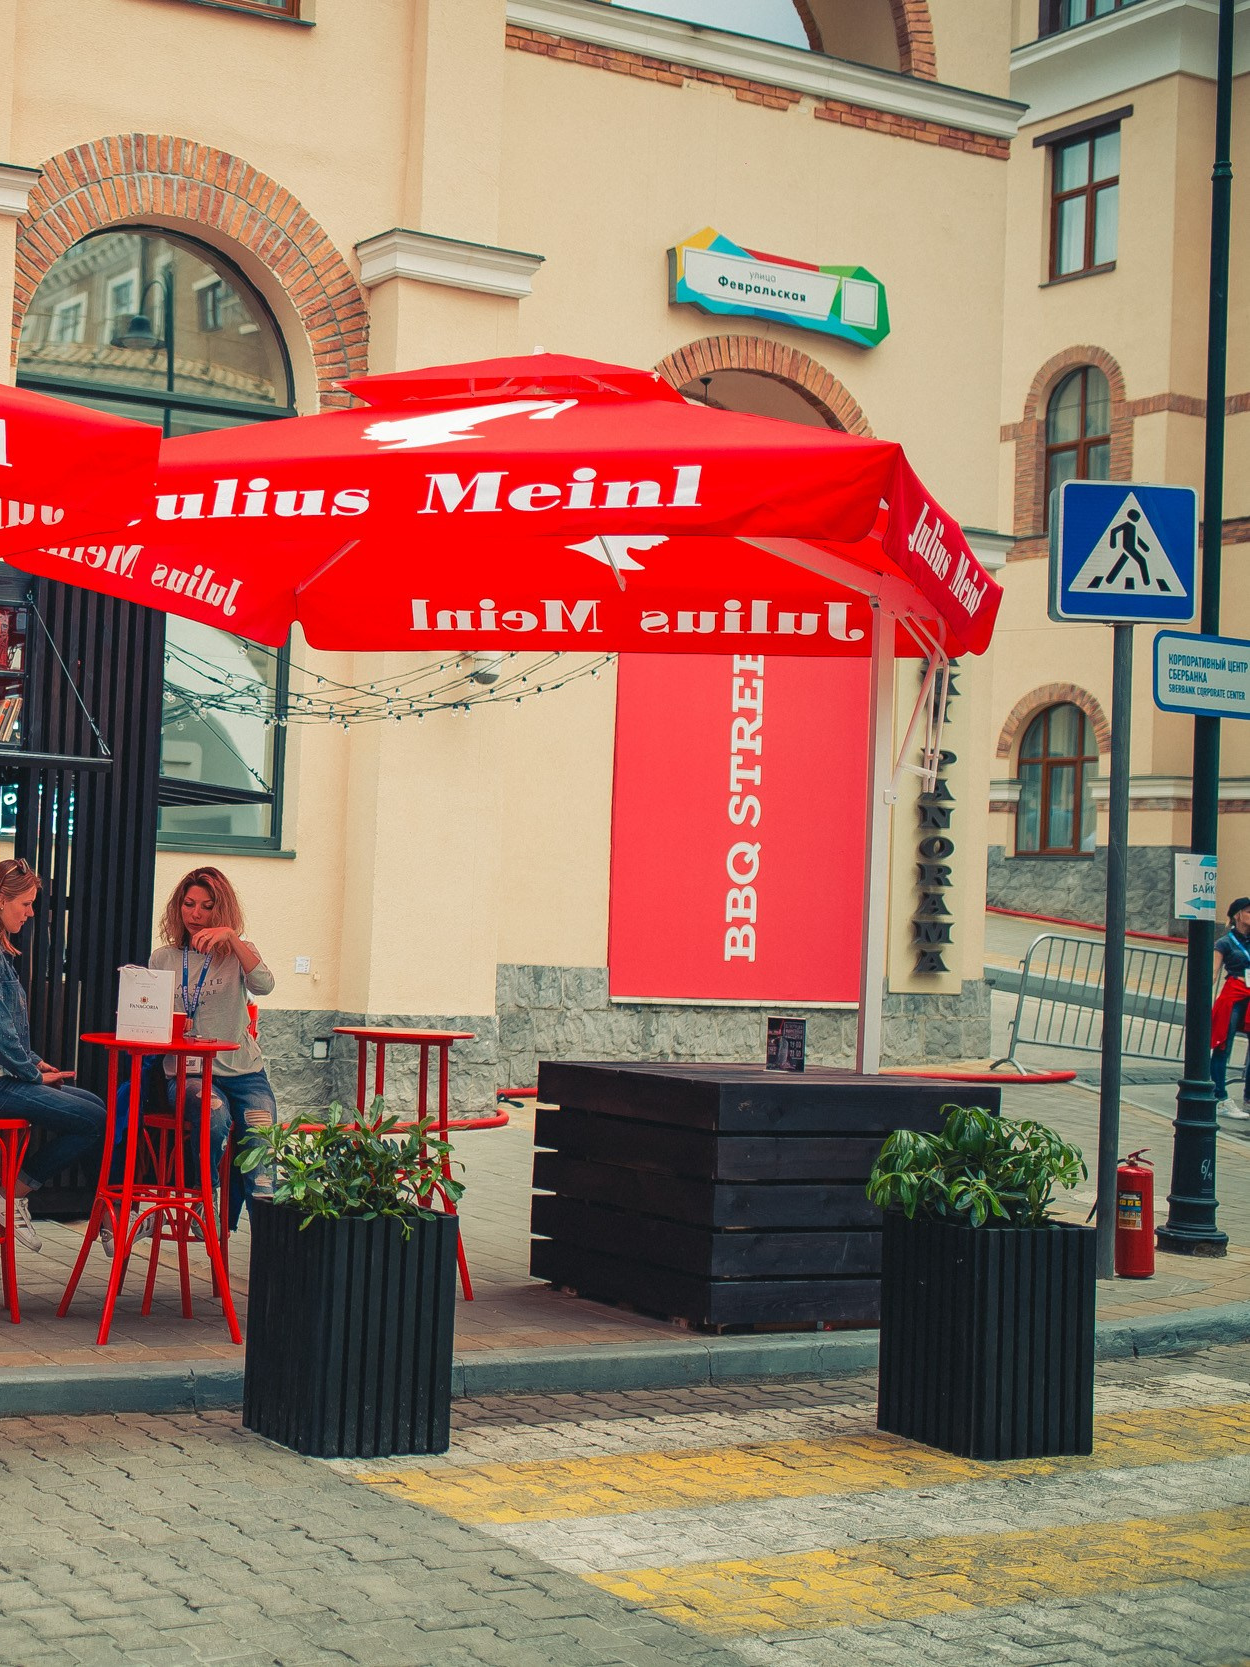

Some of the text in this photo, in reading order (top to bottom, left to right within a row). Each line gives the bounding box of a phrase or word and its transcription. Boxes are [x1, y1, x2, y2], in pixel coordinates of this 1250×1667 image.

[749, 270, 777, 284] улица
[717, 275, 807, 303] Февральская
[153, 464, 703, 521] ulius Meinl
[908, 501, 988, 618] Julius Meinl
[1168, 653, 1249, 674] КОРПОРАТИВНЫЙ ЦЕНТР
[1168, 668, 1208, 683] СБЕРБАНКА
[1168, 683, 1246, 701] SBERBANK CORPORATE CENTER
[724, 654, 765, 963] BBQ STREE
[1192, 882, 1216, 895] БАЙК
[129, 1002, 159, 1010] FANAGORIA
